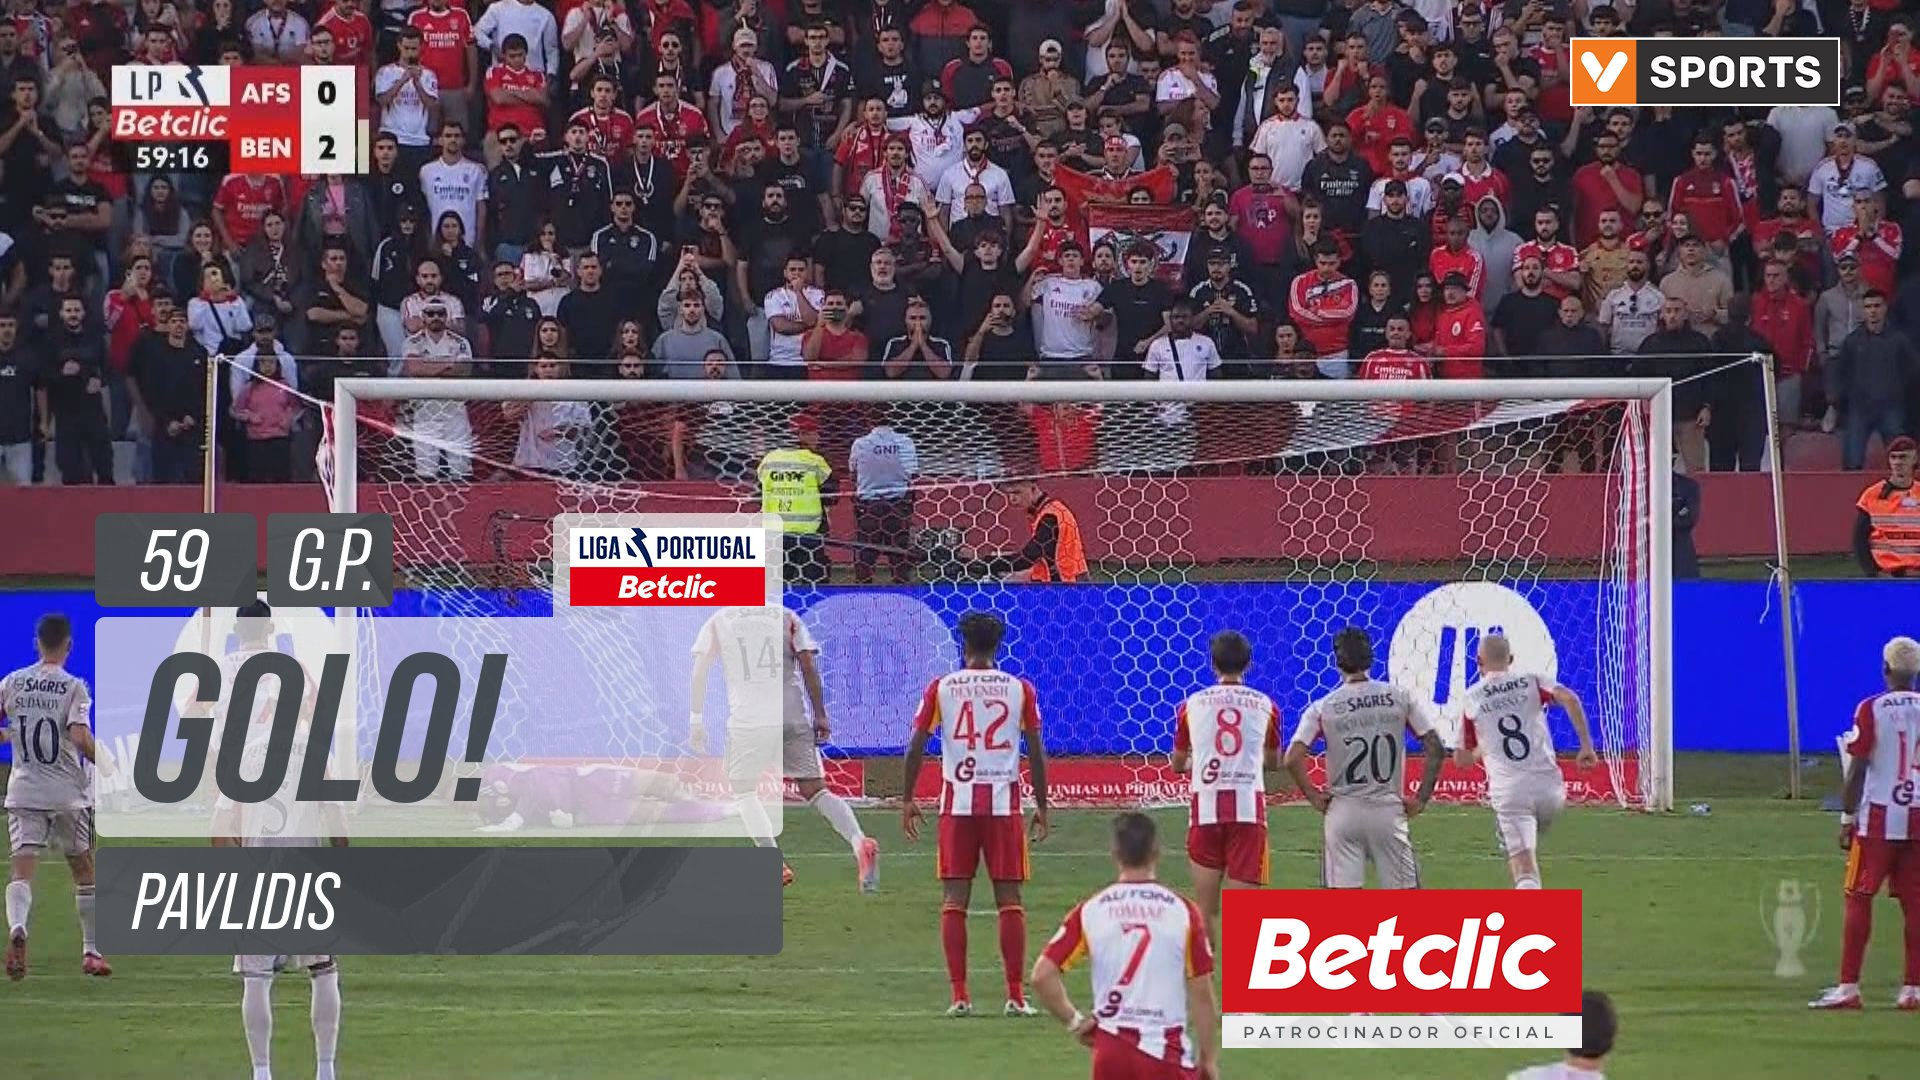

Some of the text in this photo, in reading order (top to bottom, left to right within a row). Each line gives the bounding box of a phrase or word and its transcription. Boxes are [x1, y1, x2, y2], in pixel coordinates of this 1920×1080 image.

[24, 677, 68, 694] SAGRES
[1347, 693, 1394, 712] SAGRES
[1483, 676, 1529, 698] SAGRES
[18, 715, 60, 765] 10
[953, 700, 1012, 751] 42
[1215, 707, 1243, 757] 8
[1497, 713, 1530, 761] 8
[1343, 733, 1397, 785] 20
[1103, 783, 1121, 794] DA
[1125, 782, 1192, 795] PRIMAVE
[1117, 923, 1151, 986] 7
